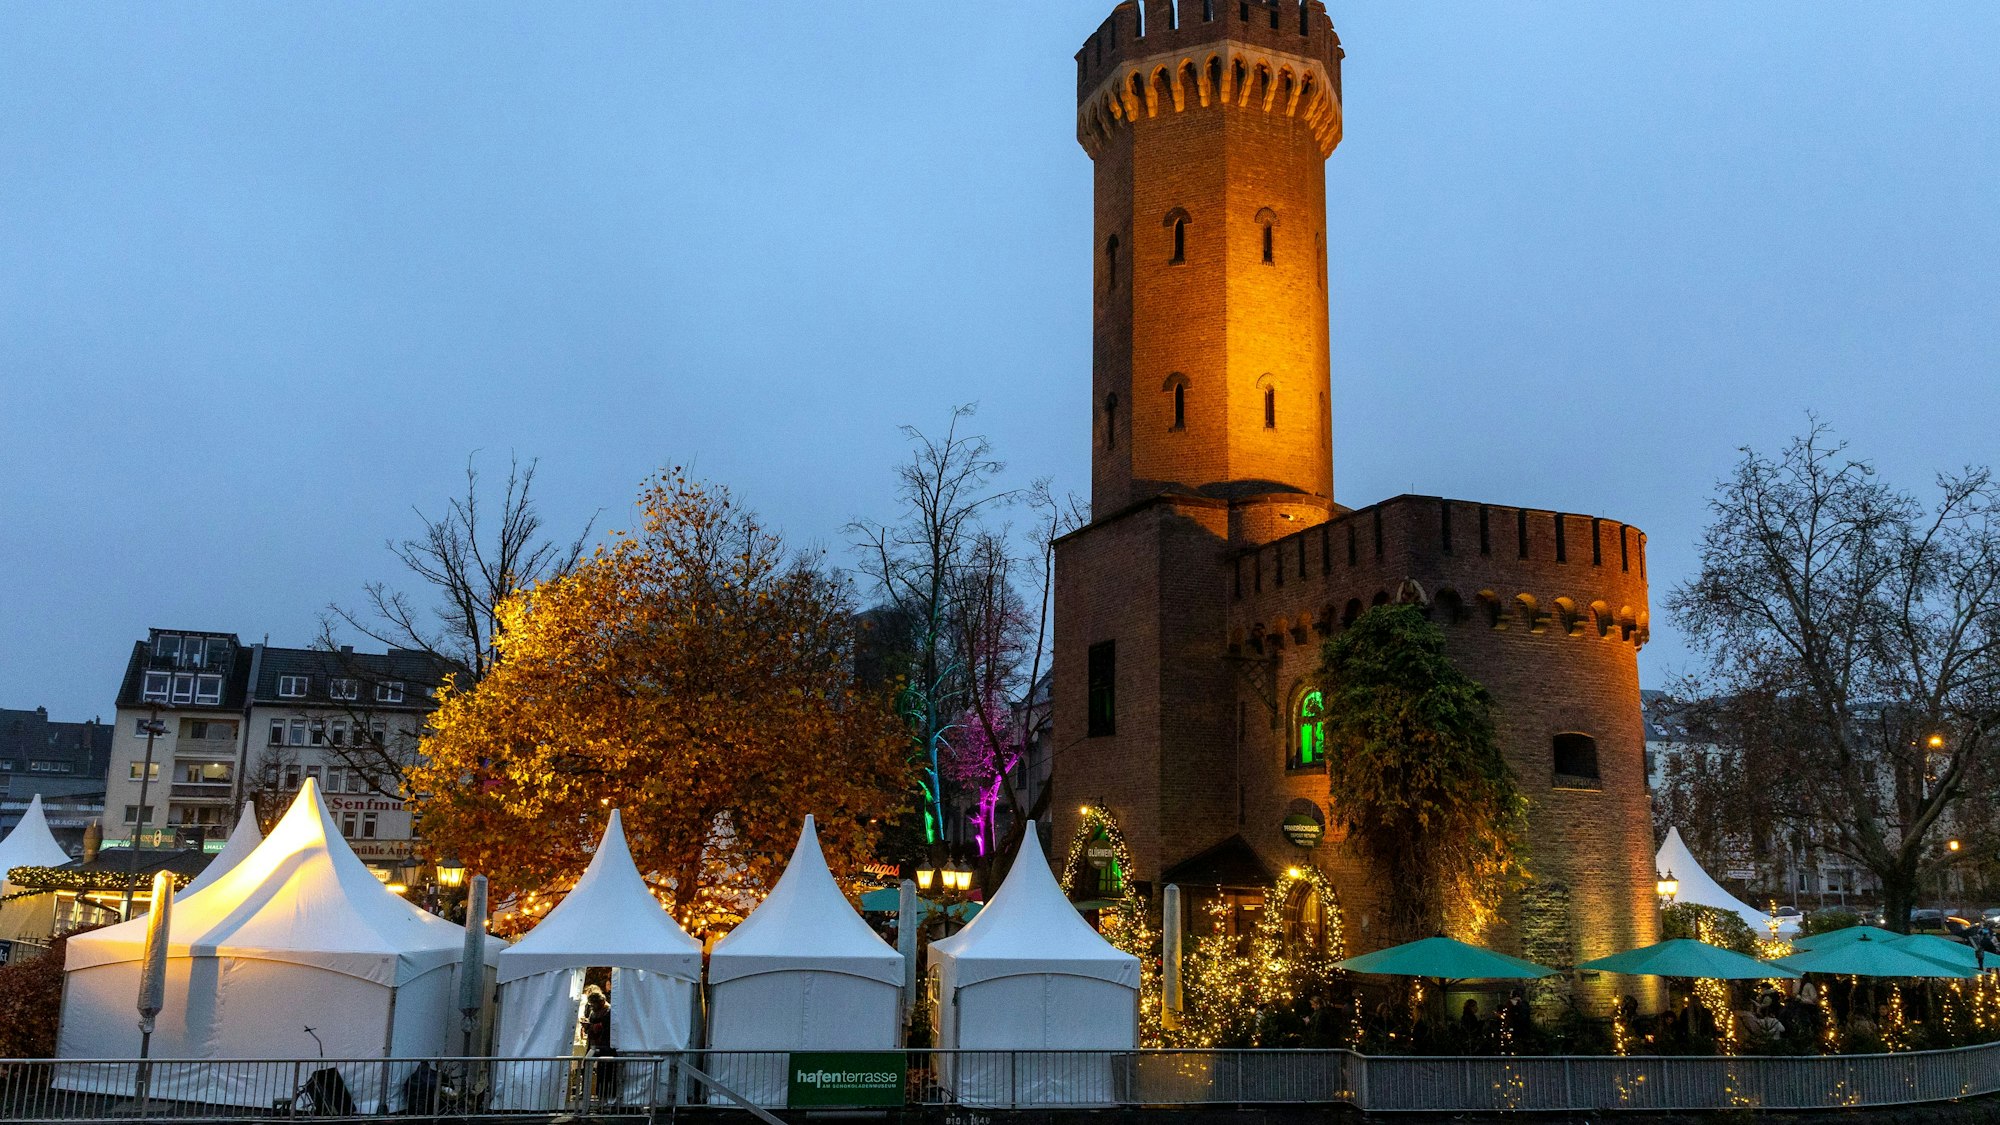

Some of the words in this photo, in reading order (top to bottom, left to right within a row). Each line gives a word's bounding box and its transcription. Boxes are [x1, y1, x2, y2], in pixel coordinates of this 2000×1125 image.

[332, 797, 402, 811] Senfmu
[47, 818, 84, 826] ARAGEN
[353, 845, 384, 855] mühle
[1087, 846, 1113, 857] GLÜHWEIN
[863, 864, 900, 880] ungos
[797, 1069, 898, 1089] hafenterrasse
